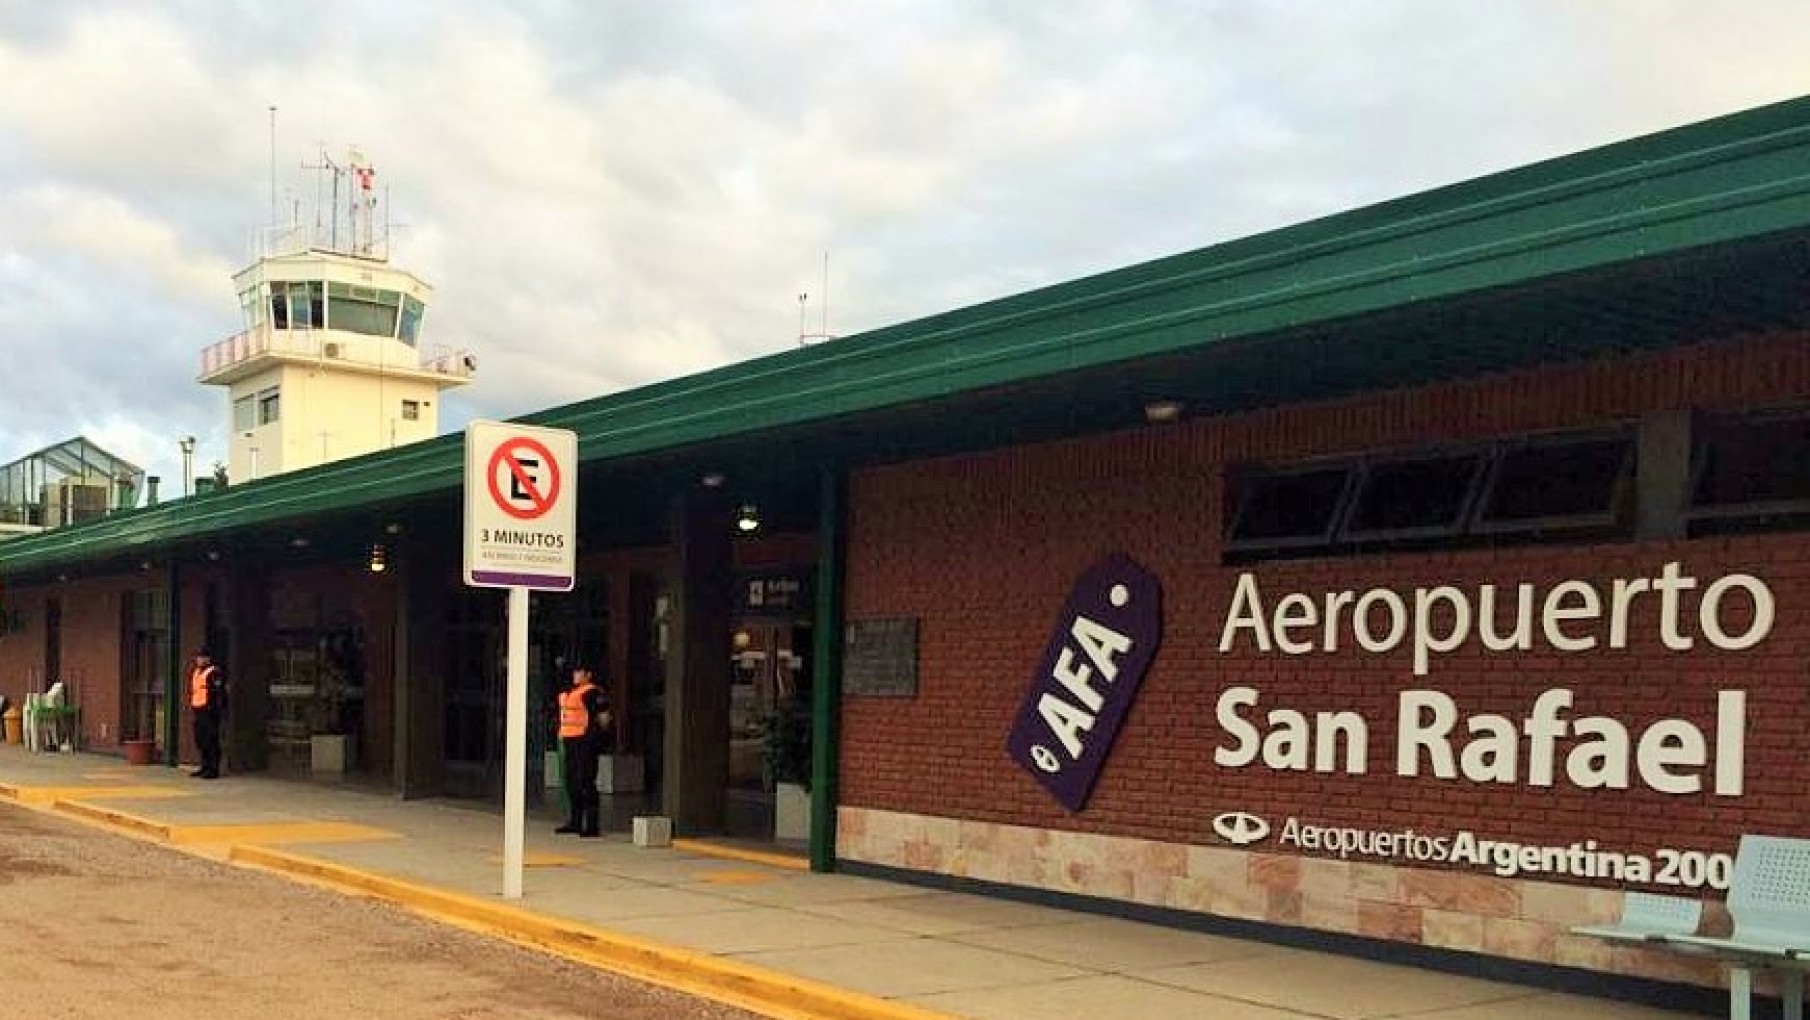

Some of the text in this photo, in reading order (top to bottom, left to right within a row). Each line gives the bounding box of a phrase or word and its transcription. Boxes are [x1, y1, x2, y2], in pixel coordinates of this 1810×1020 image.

[511, 459, 539, 500] E
[481, 529, 564, 548] 3 MINUTOS
[1219, 561, 1776, 675] Aeropuerto
[1038, 615, 1133, 759] AFA
[1214, 687, 1746, 796] San Rafael
